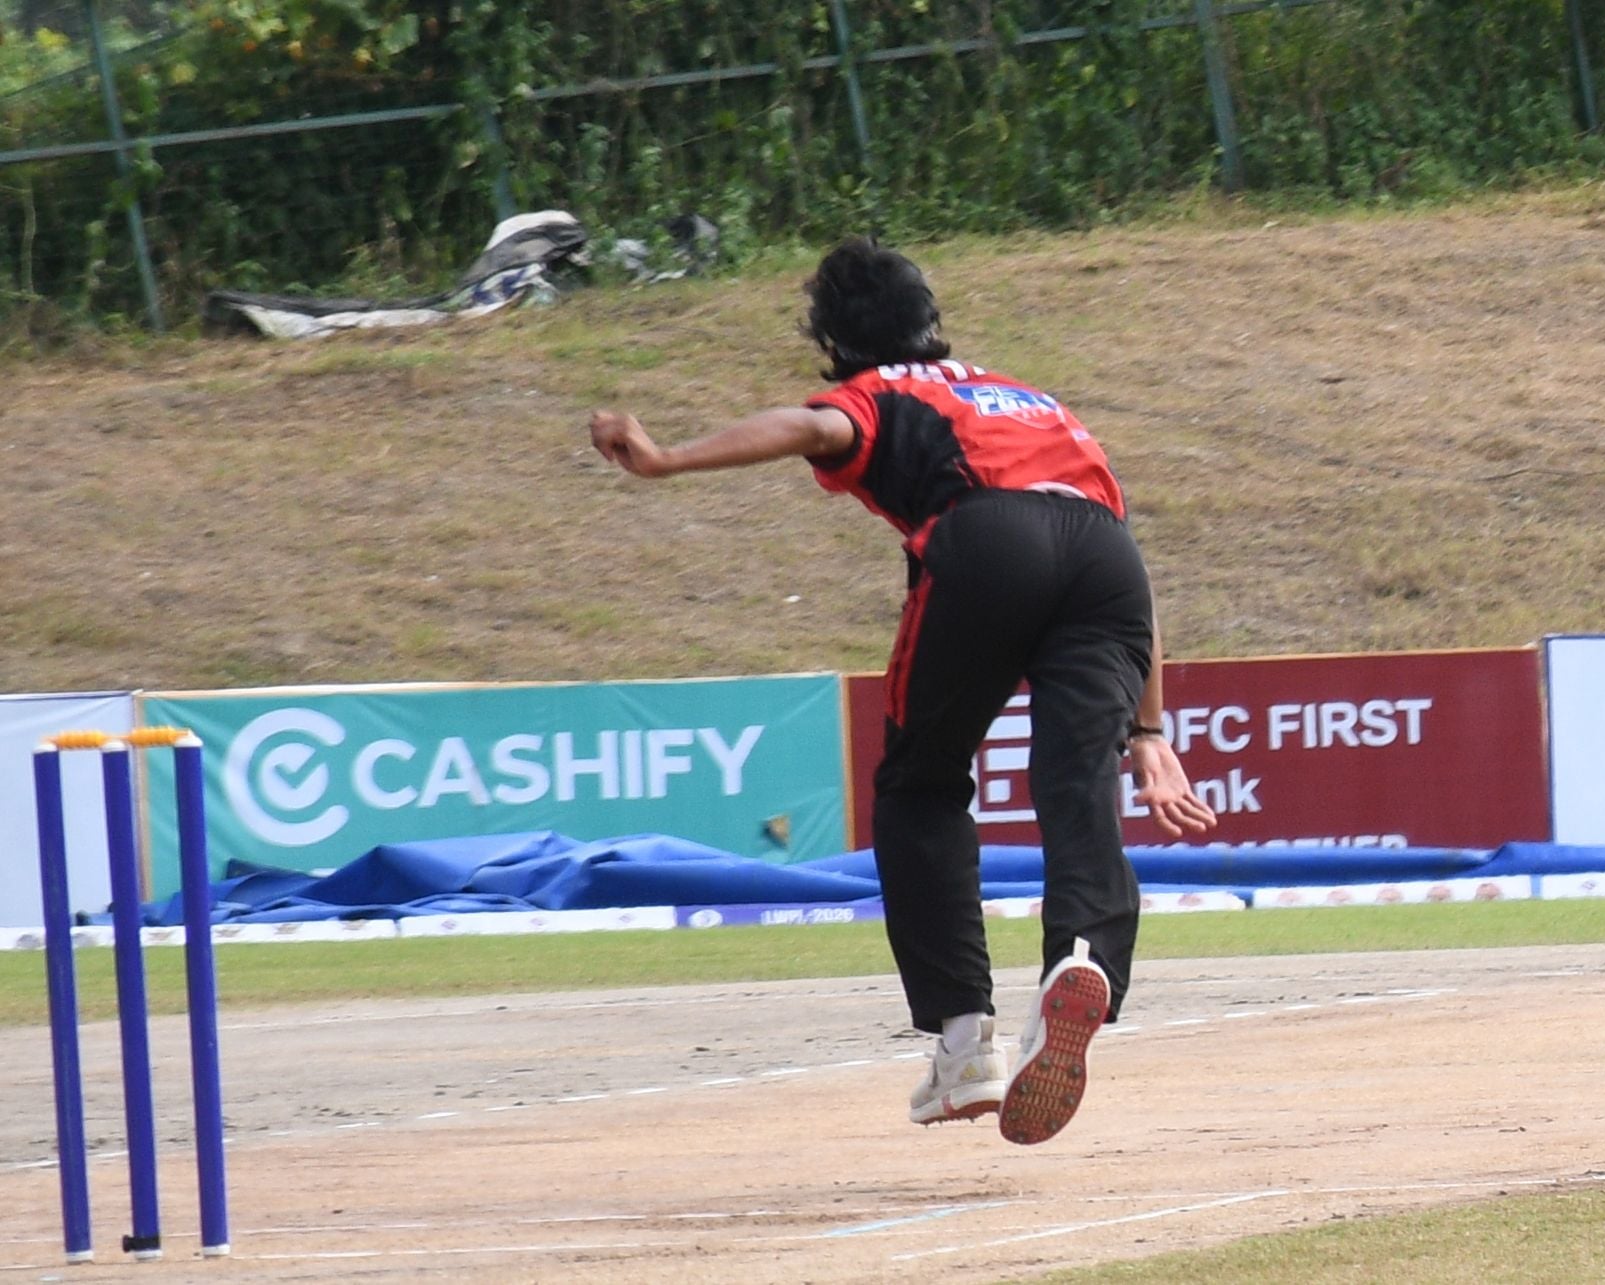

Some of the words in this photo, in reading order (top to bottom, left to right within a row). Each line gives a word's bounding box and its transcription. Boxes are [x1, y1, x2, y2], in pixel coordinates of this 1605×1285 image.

[1160, 705, 1252, 753] FC
[1267, 698, 1433, 750] FIRST
[351, 724, 766, 809] CASHIFY
[1120, 768, 1262, 818] Bnk
